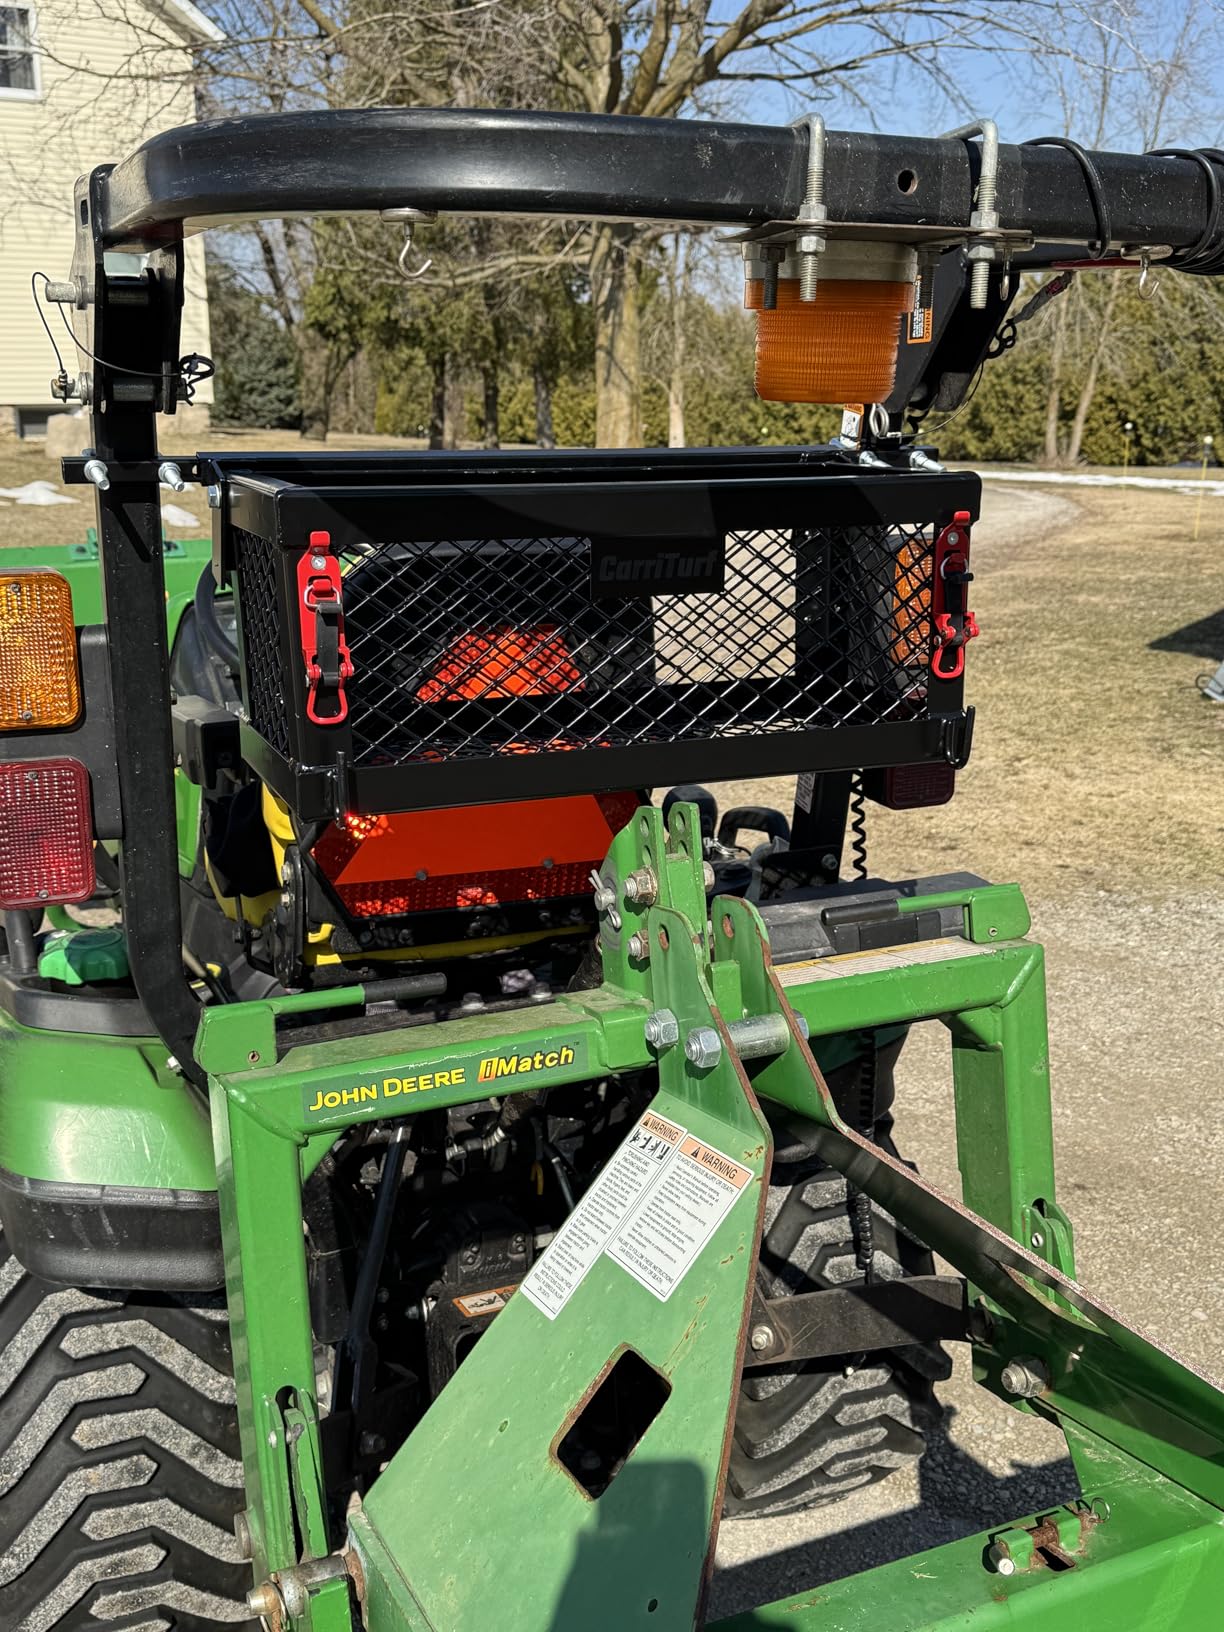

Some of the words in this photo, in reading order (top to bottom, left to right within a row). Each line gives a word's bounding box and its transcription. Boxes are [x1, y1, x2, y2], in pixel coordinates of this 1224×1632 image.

[599, 550, 718, 582] CarriTurf
[309, 1084, 378, 1111] JOHN
[383, 1068, 465, 1098] DEERE
[648, 1118, 678, 1141] WARNING
[700, 1150, 737, 1179] WARNING
